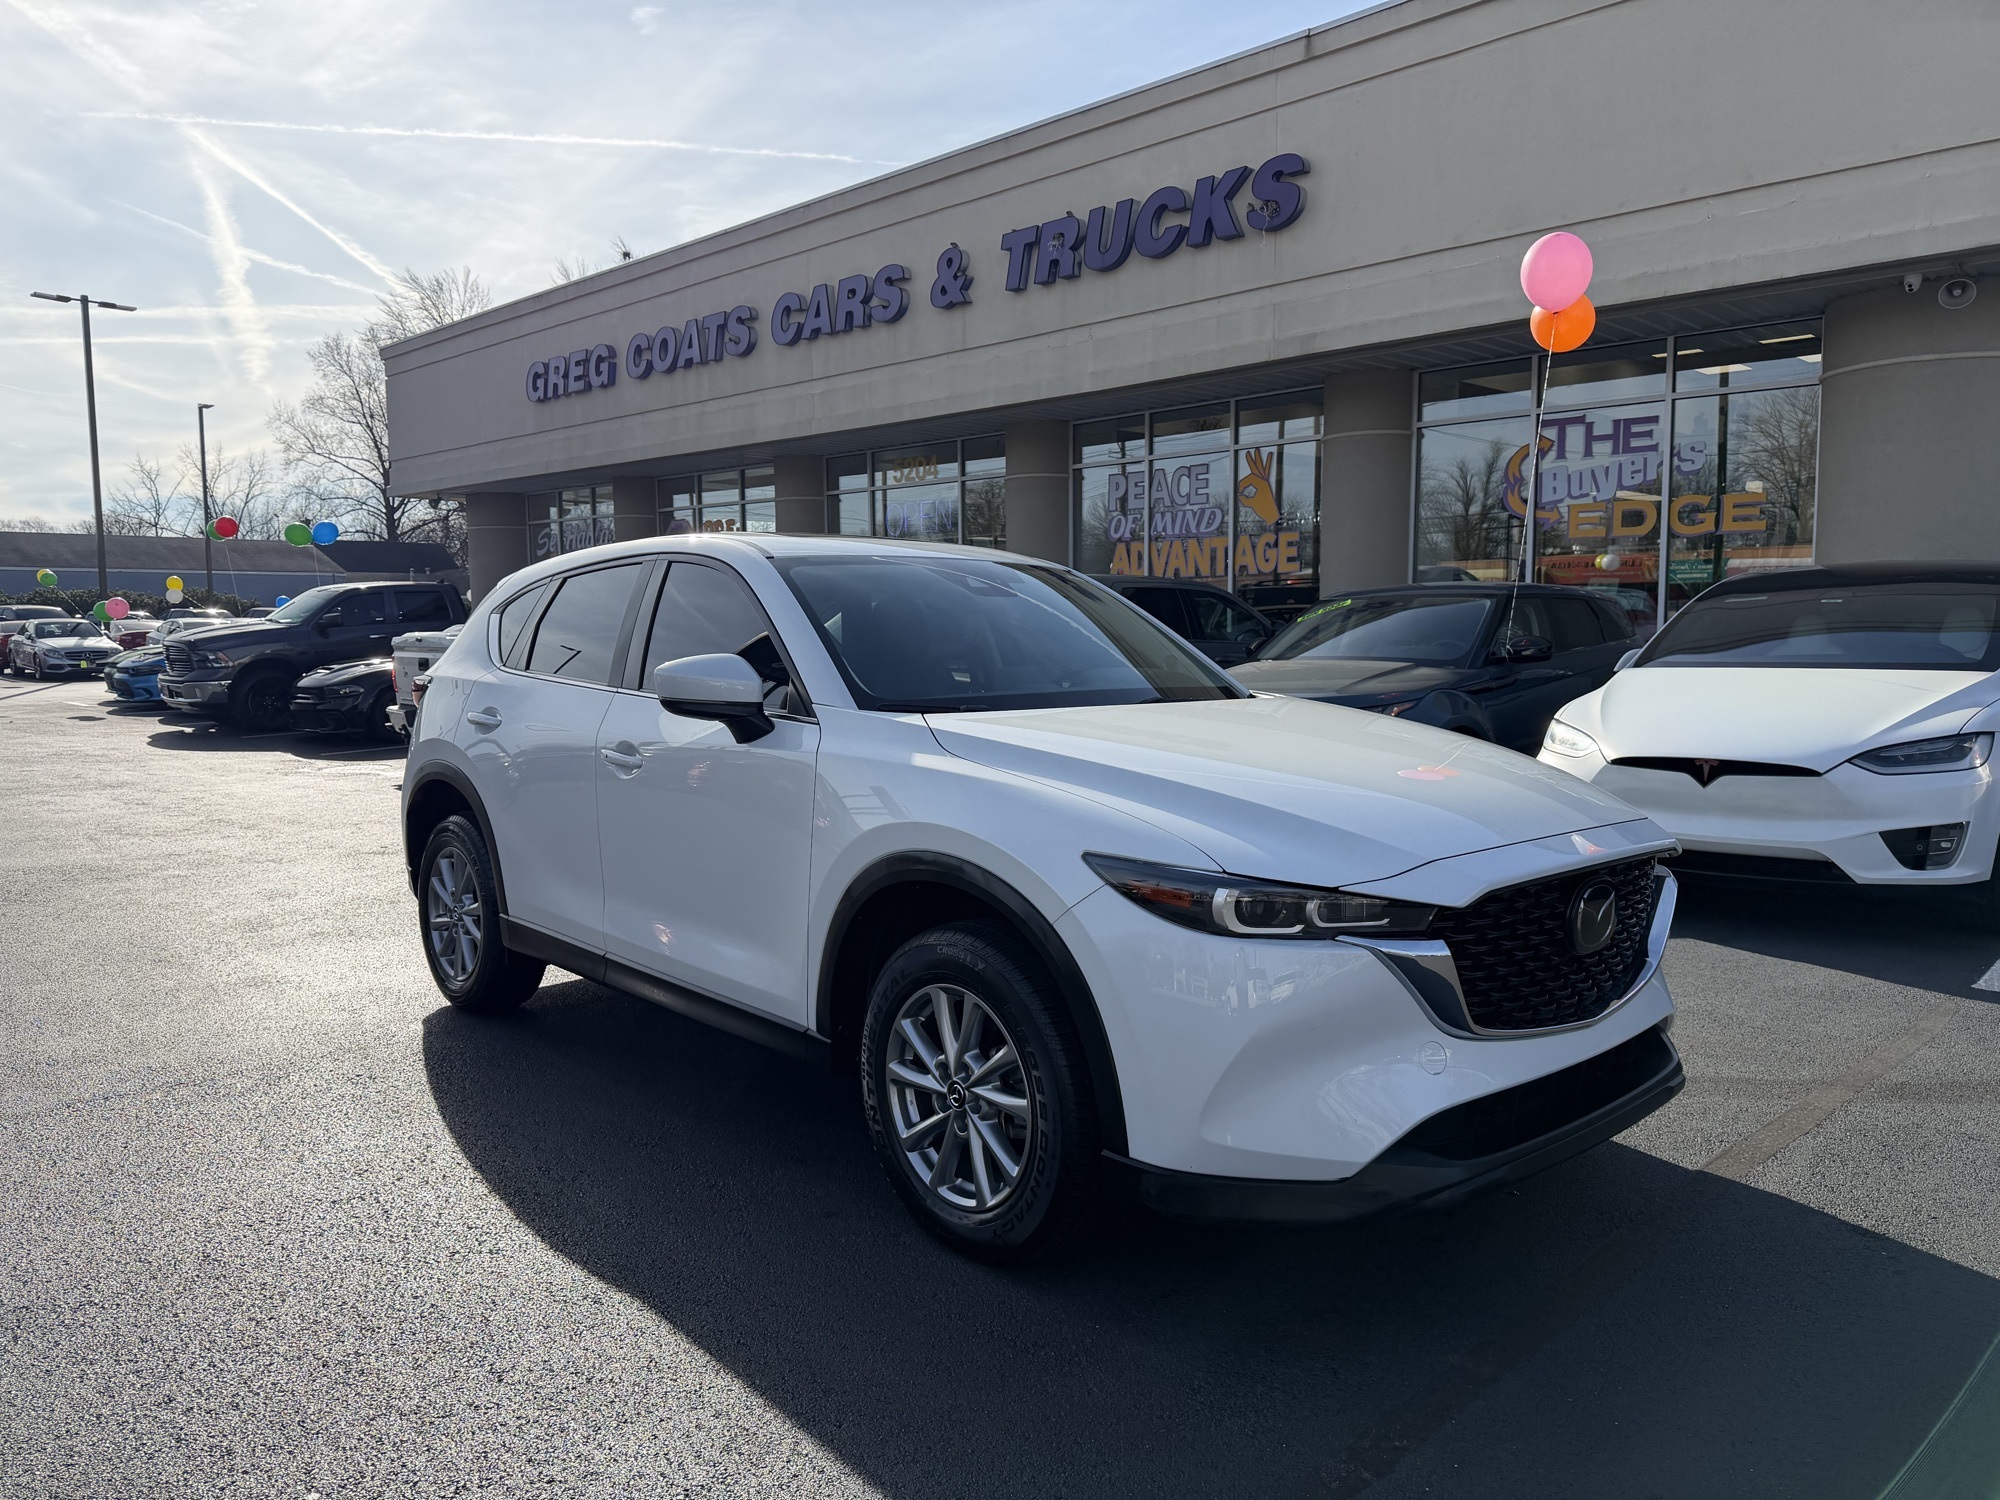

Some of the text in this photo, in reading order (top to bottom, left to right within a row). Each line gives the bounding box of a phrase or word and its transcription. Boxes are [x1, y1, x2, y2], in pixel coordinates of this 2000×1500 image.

[526, 152, 1312, 402] GREG COATS CARS & TRUCKS
[1540, 415, 1660, 460] THE
[892, 454, 939, 483] 5204
[1108, 463, 1209, 512] PEACE
[1540, 440, 1708, 503] Buyer's
[886, 499, 952, 537] OPEN
[1108, 508, 1224, 541] OF MIND
[1566, 492, 1769, 541] EDGE
[1110, 531, 1301, 578] ADVANTAGE
